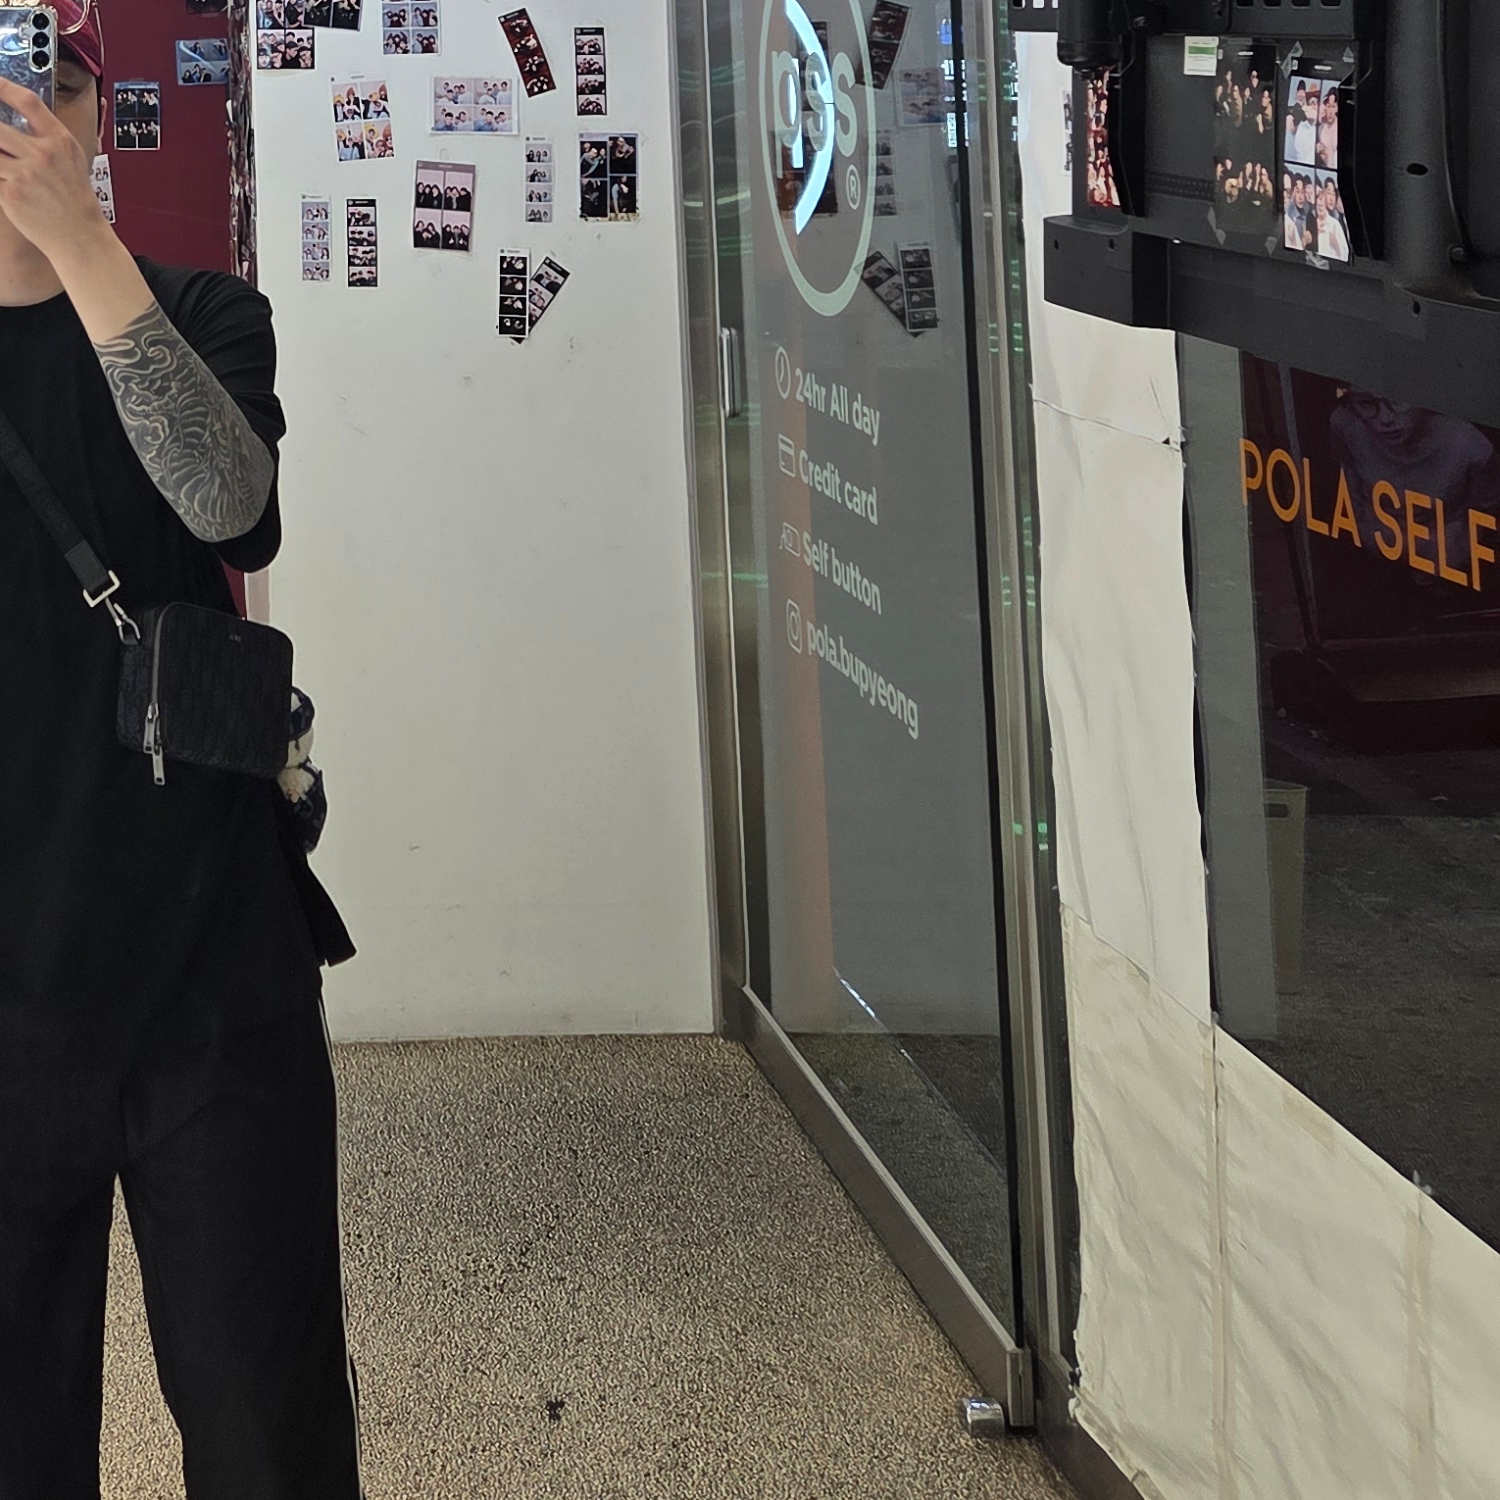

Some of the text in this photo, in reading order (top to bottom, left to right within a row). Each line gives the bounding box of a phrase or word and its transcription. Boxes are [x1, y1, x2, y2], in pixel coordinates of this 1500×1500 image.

[795, 367, 880, 446] 24hr All day
[799, 449, 878, 526] Credit card
[1239, 437, 1497, 592] POLA SELF
[802, 531, 882, 616] Self button
